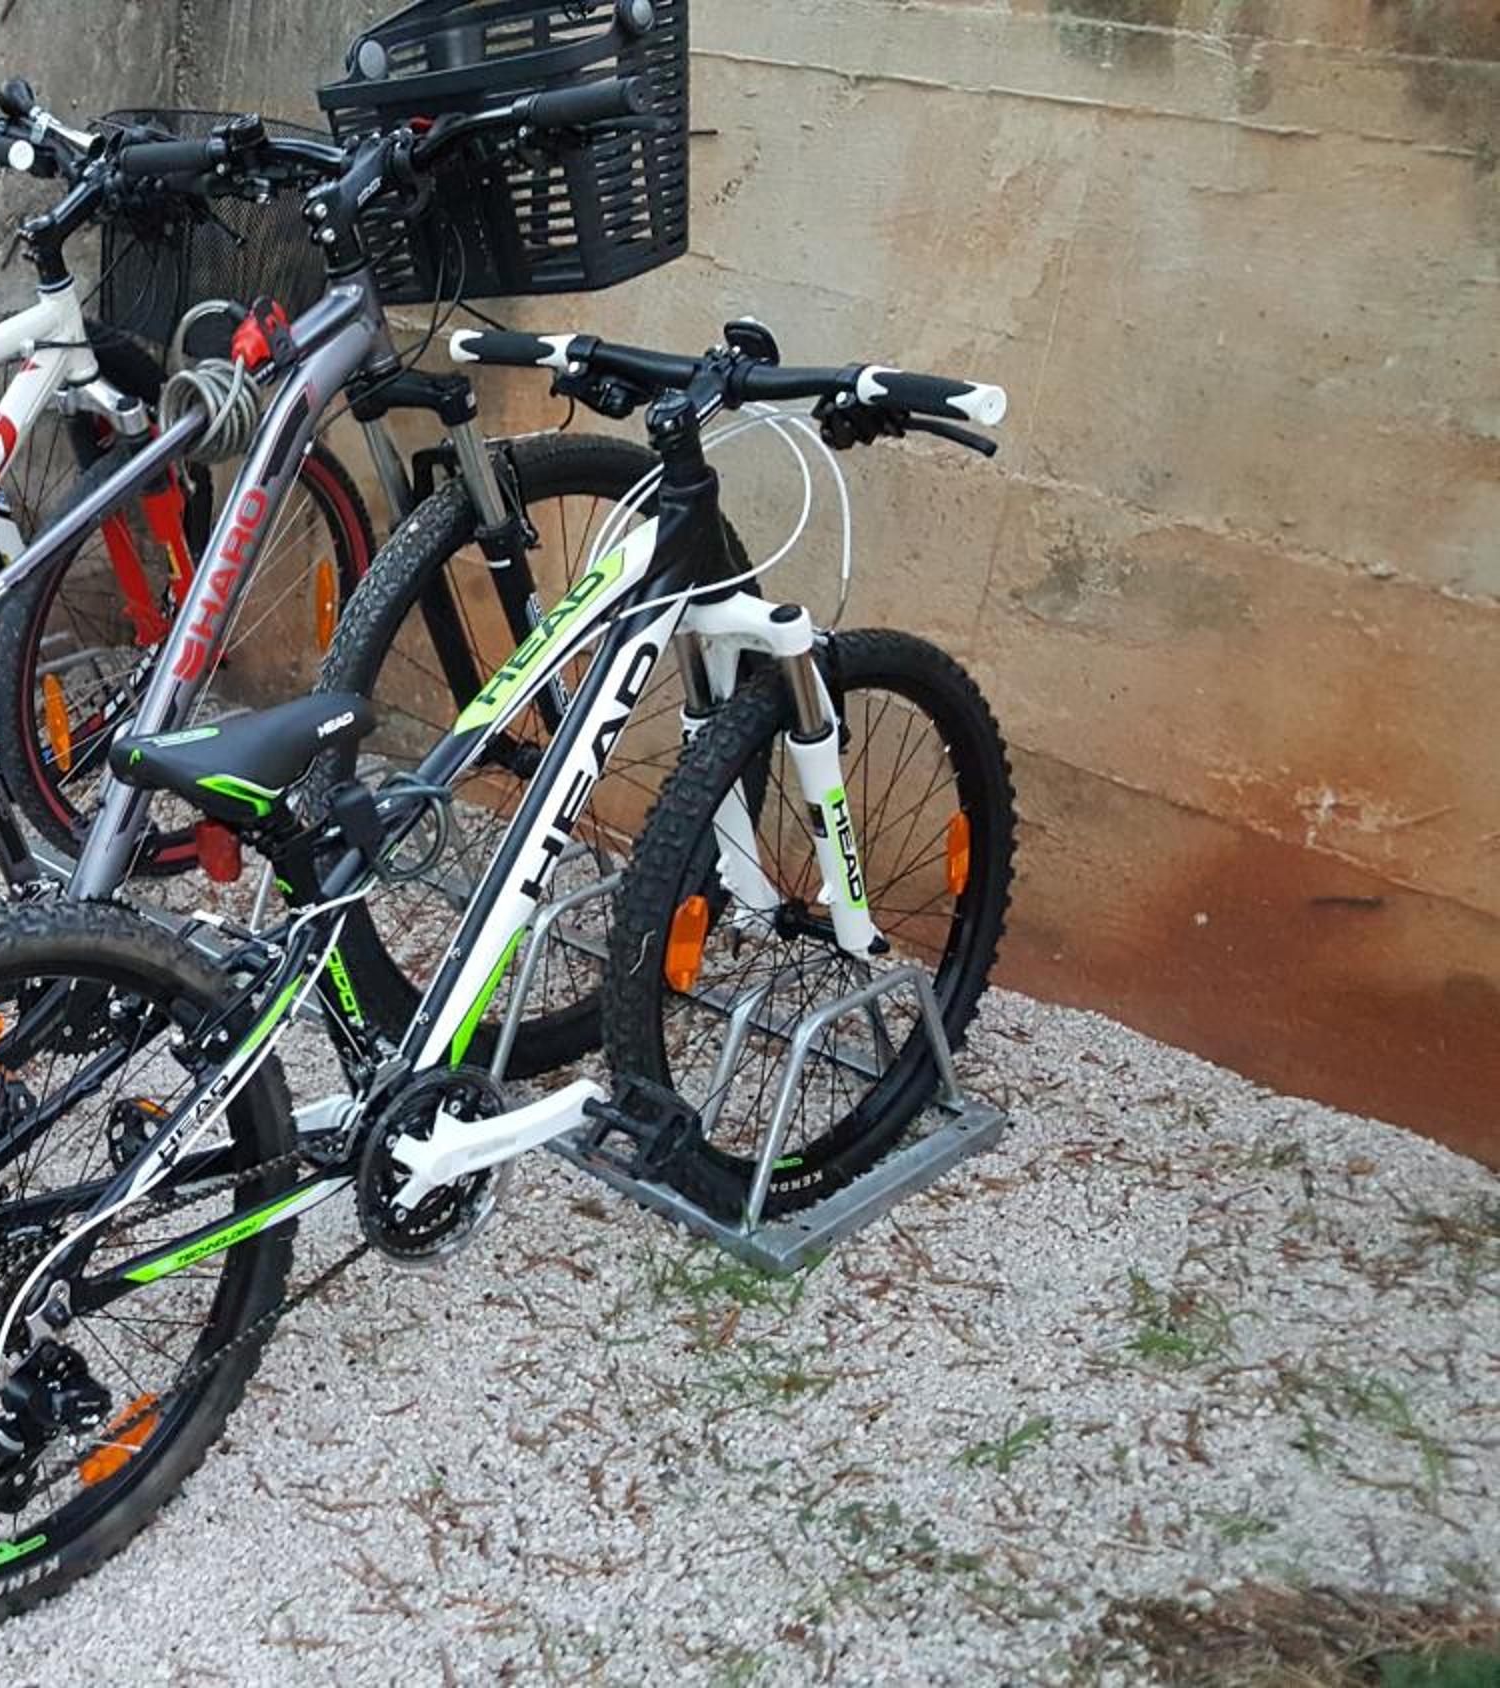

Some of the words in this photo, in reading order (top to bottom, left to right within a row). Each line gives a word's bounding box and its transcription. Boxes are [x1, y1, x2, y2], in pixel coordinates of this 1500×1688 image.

[475, 571, 605, 705] HEAD
[317, 711, 355, 738] HEAD
[520, 641, 659, 900] HEAD
[832, 798, 863, 903] HEAD
[769, 1169, 823, 1194] KENDA
